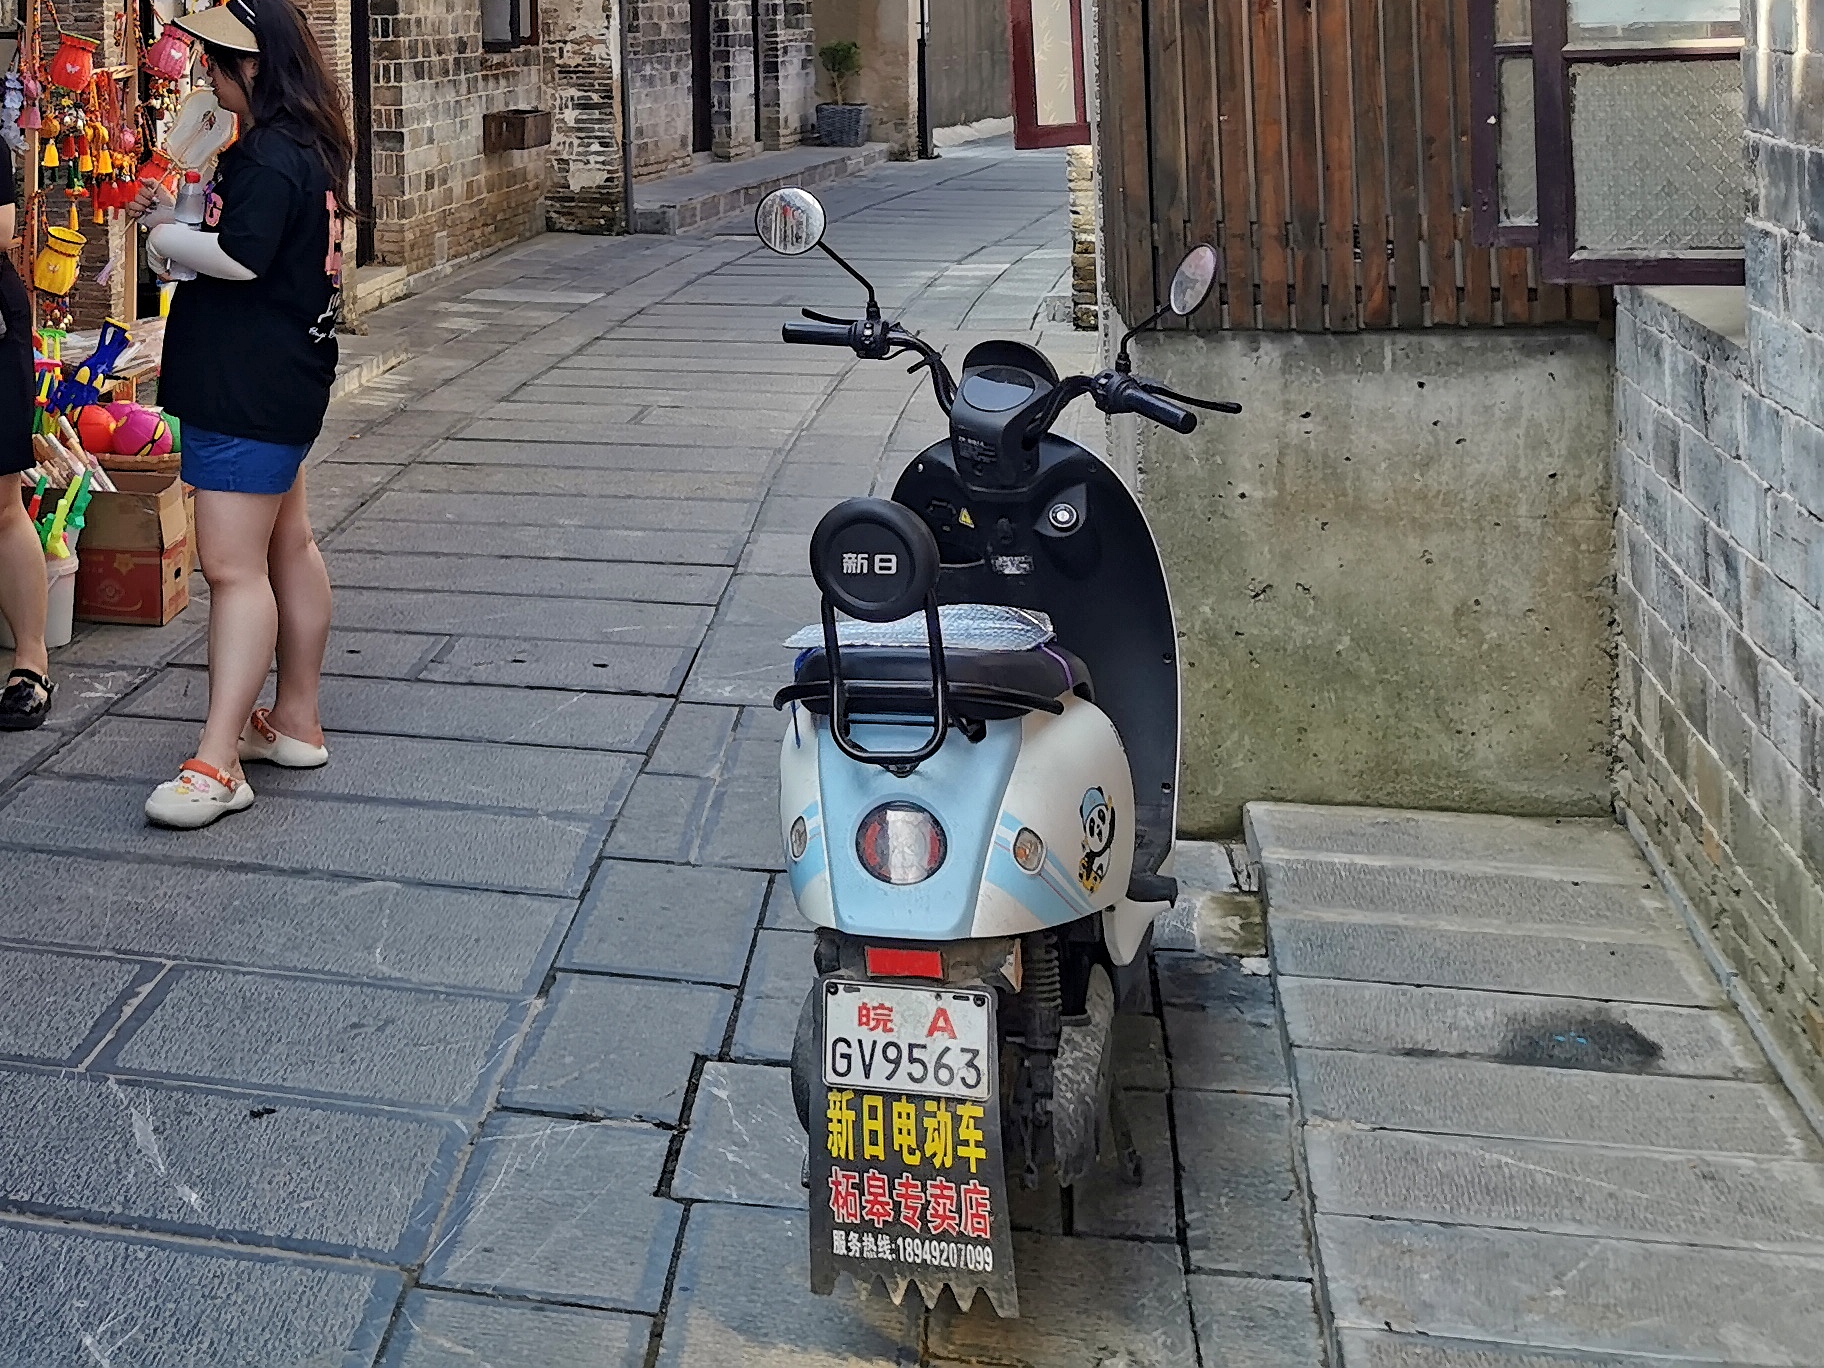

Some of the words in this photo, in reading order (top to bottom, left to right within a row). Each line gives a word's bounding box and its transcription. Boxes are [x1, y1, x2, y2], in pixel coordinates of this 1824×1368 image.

[842, 552, 898, 575] 新日
[857, 1001, 895, 1034] 皖
[926, 1006, 958, 1040] A
[831, 1036, 983, 1090] GV9563
[826, 1088, 988, 1174] 新日电动车
[828, 1166, 992, 1239] 柘皋专卖店
